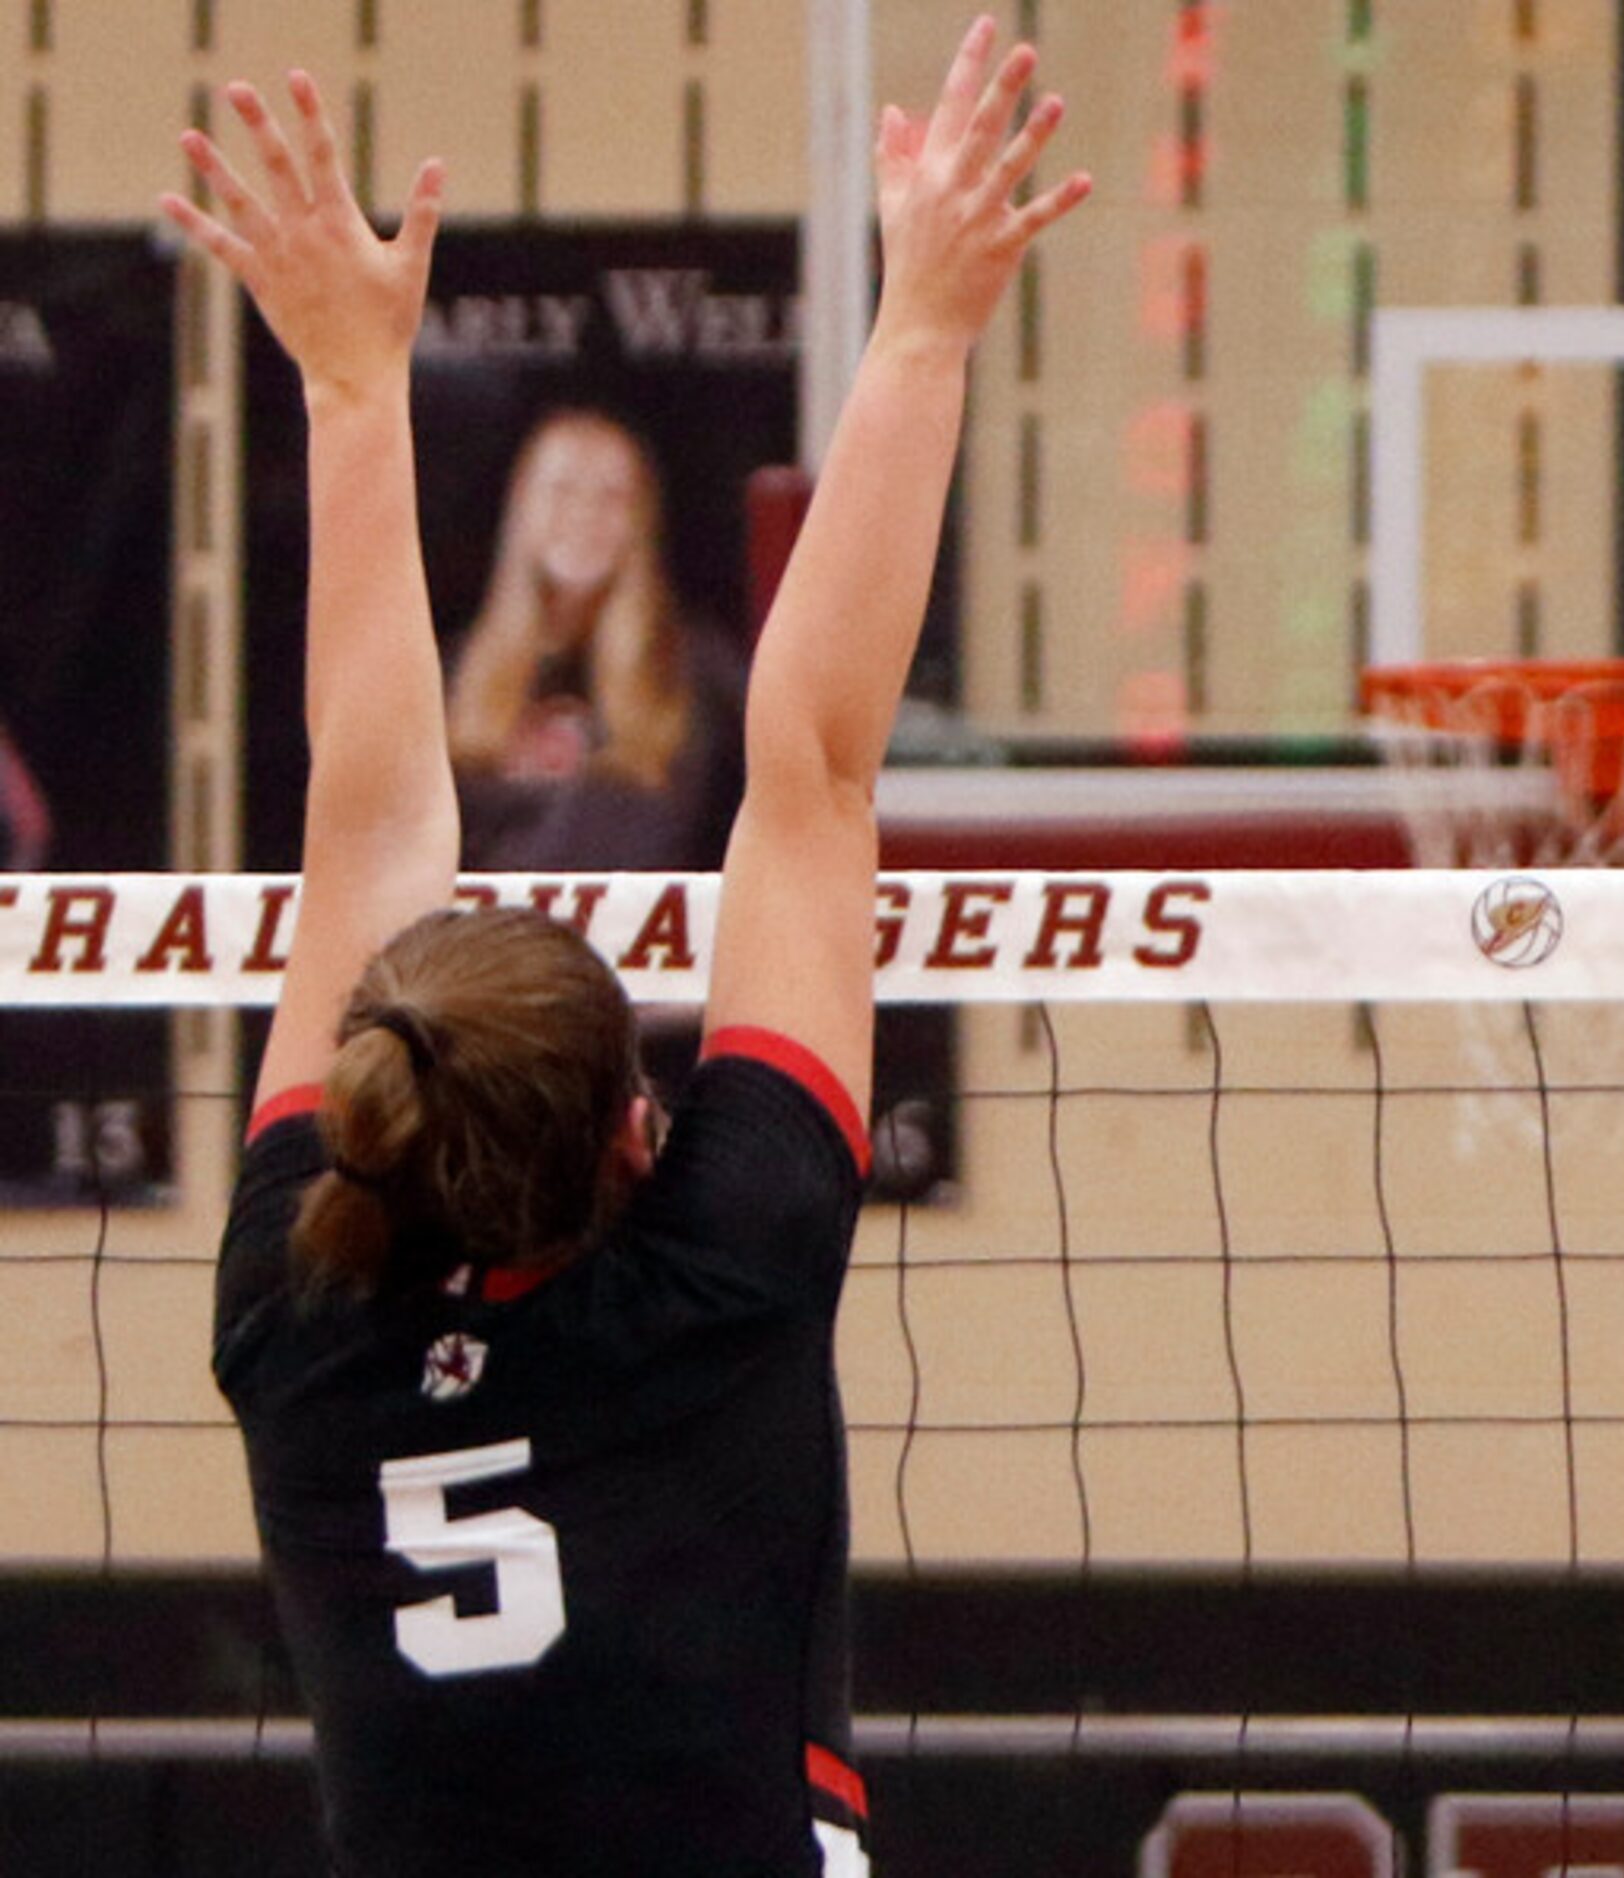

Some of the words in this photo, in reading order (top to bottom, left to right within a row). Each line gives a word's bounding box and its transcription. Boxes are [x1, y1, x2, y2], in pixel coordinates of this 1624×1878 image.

[0, 884, 295, 973] RAL
[456, 880, 1212, 971] AGERS
[380, 1436, 567, 1678] 5
